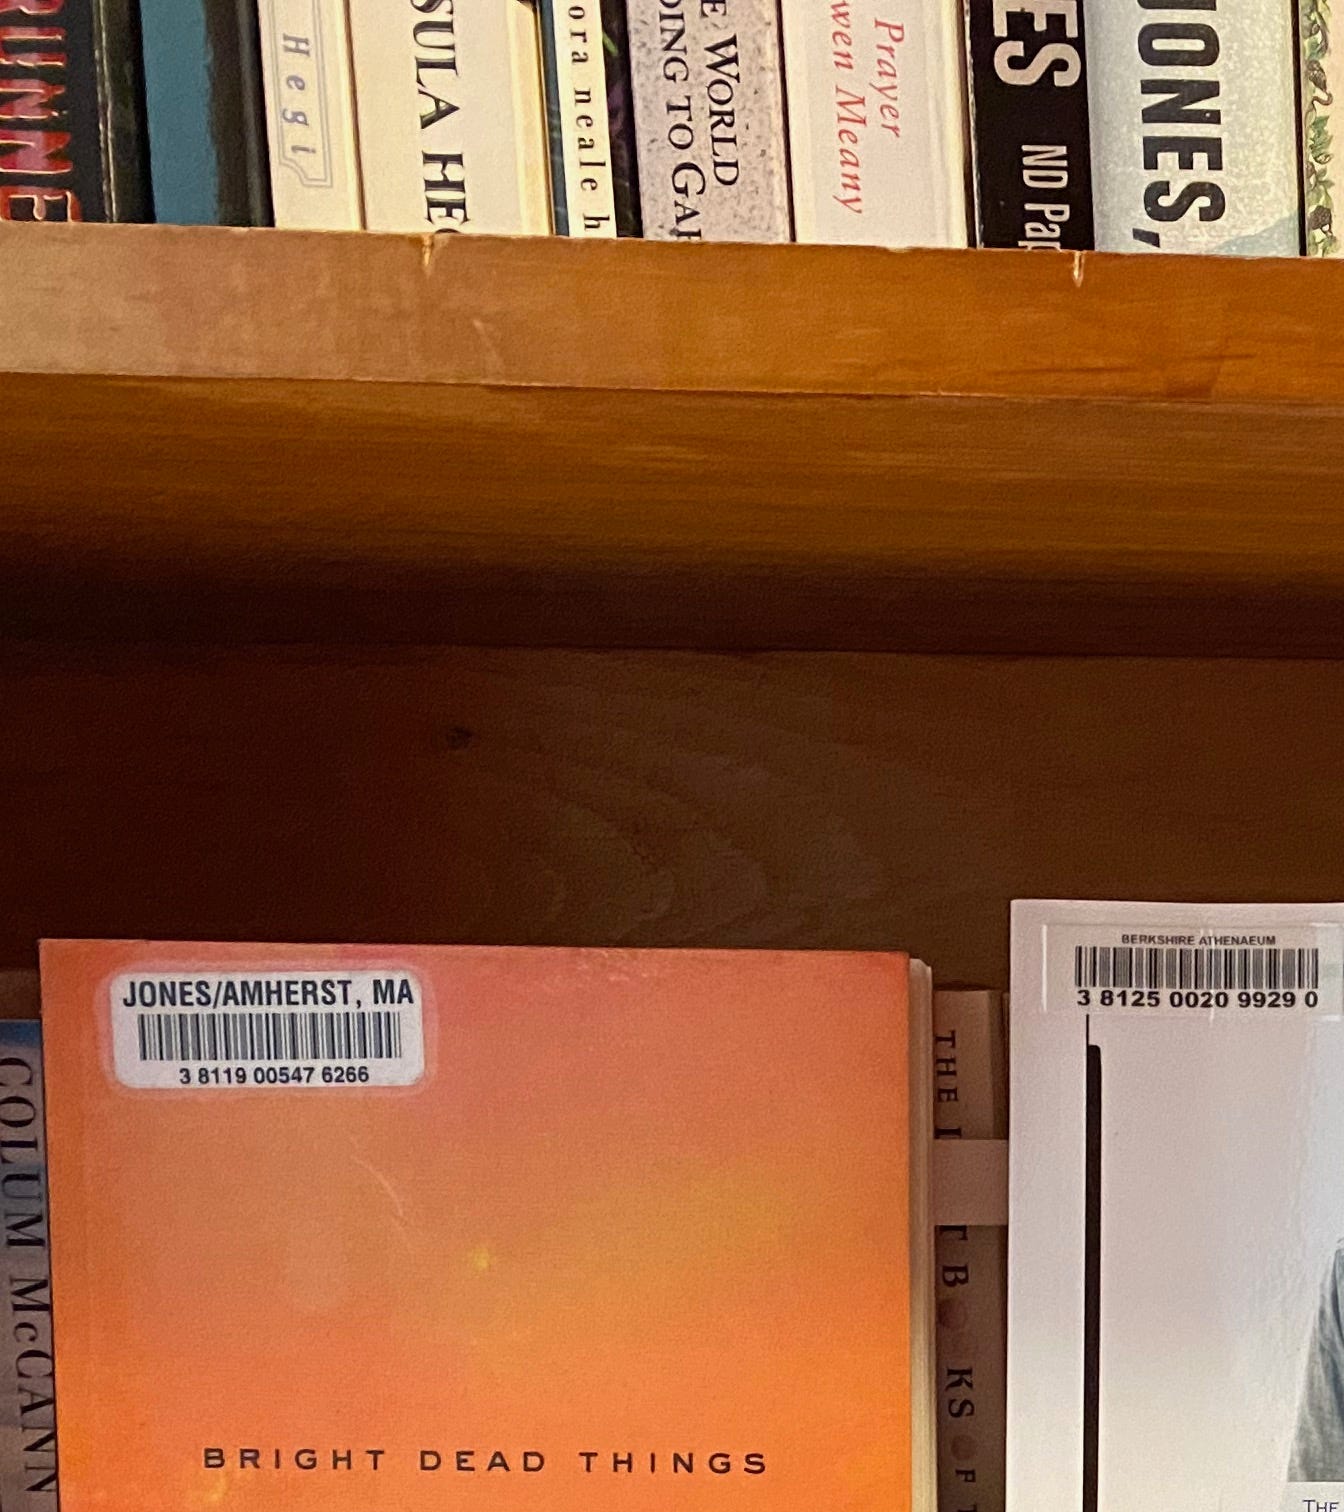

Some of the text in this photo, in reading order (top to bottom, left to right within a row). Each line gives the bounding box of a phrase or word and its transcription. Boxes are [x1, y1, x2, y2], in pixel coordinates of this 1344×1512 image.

[872, 18, 905, 137] Prayer
[573, 88, 602, 192] neale
[666, 96, 693, 151] TO
[703, 35, 739, 187] WORLD
[832, 84, 867, 215] Meany
[1122, 935, 1276, 946] BERKSHIRE ATHENAEUM
[122, 979, 414, 1008] JONES/AMHERST, MA
[1077, 988, 1318, 1008] 3 8125 0020 9929 0
[180, 1066, 370, 1085] 3 8119 00547 6266
[935, 1030, 957, 1102] THE
[0, 1057, 58, 1497] COLUM McCANN
[203, 1447, 770, 1476] BRIGHT DEAD THINGS
